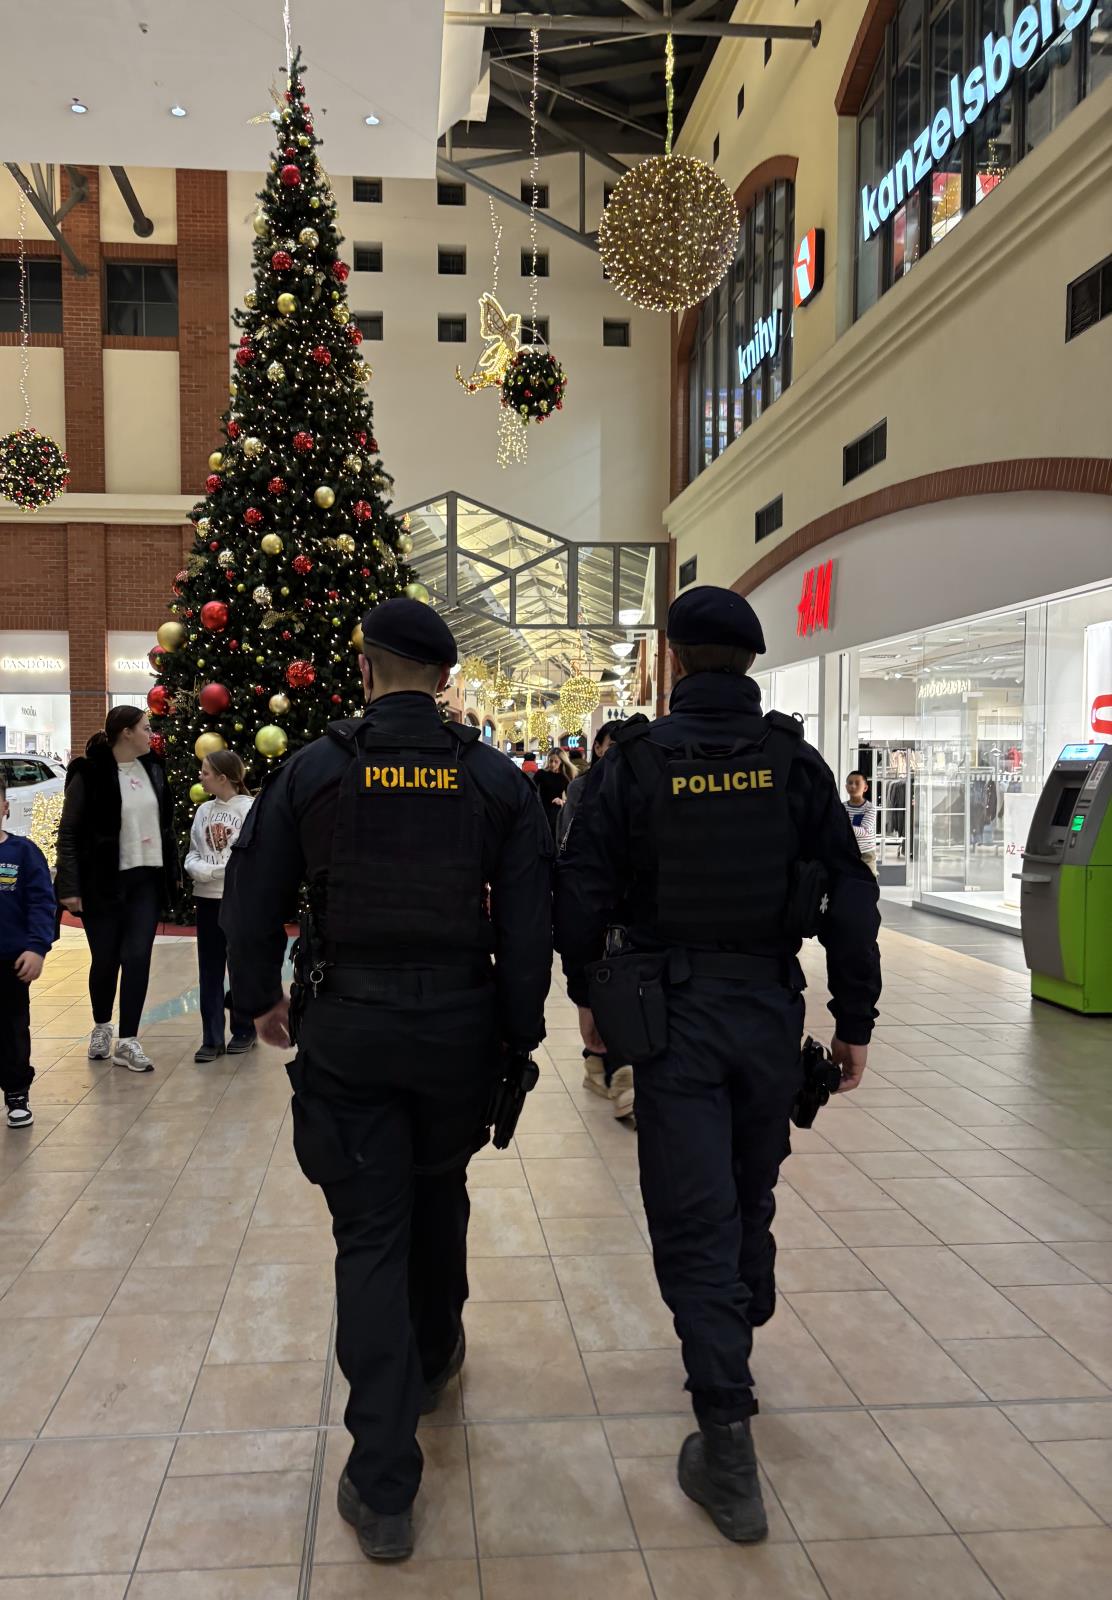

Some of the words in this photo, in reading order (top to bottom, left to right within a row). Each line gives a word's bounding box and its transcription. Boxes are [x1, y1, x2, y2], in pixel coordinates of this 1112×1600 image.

[737, 309, 778, 385] knihy
[2, 657, 63, 670] PANDORA
[365, 766, 459, 789] POLICIE
[672, 769, 774, 795] POLICIE
[201, 812, 243, 829] PLERMO
